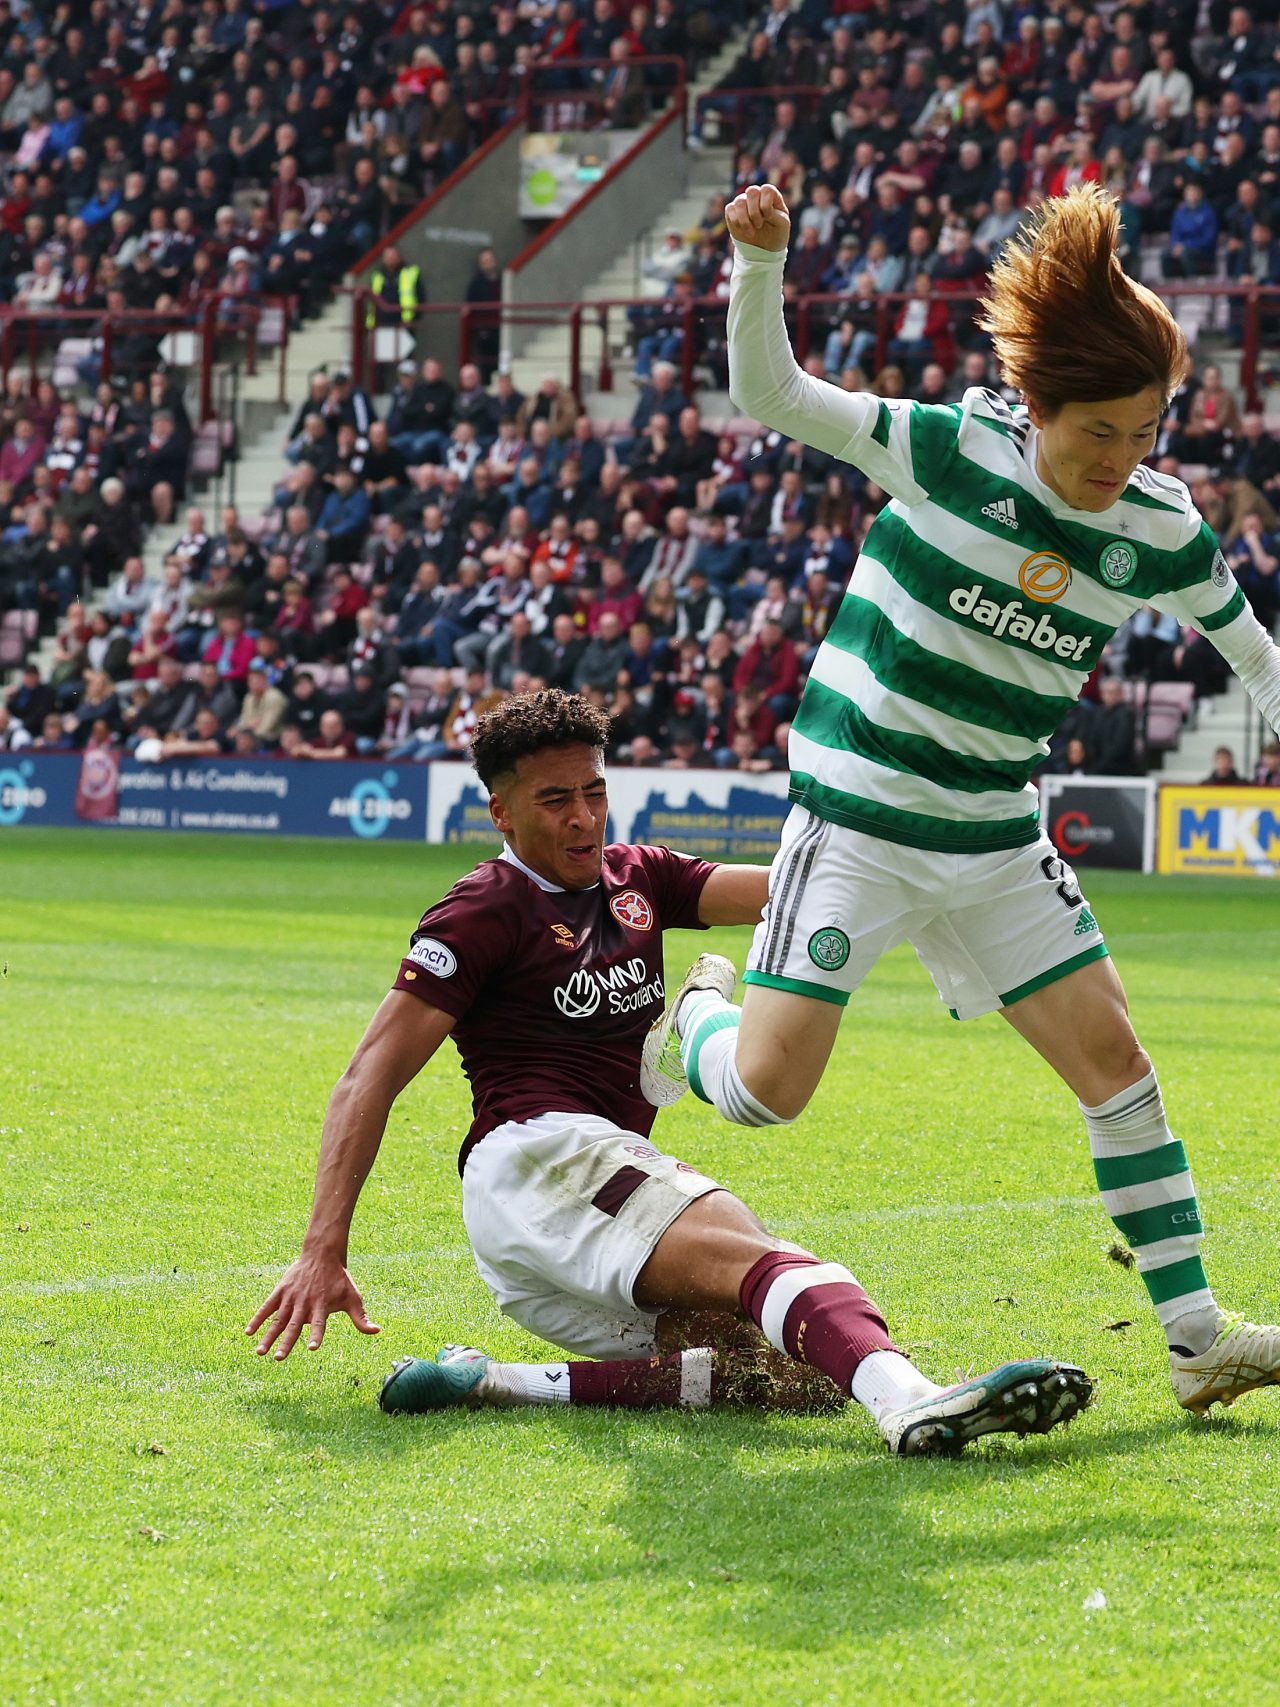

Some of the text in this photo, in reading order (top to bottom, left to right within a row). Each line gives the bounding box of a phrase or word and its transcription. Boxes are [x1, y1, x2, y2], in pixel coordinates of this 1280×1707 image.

[981, 506, 1019, 530] adidas
[949, 584, 1092, 662] dafabet
[118, 770, 166, 790] eration
[555, 937, 575, 949] umbro
[412, 944, 448, 968] cinch
[595, 957, 647, 991] MND
[608, 972, 665, 1015] Scotland
